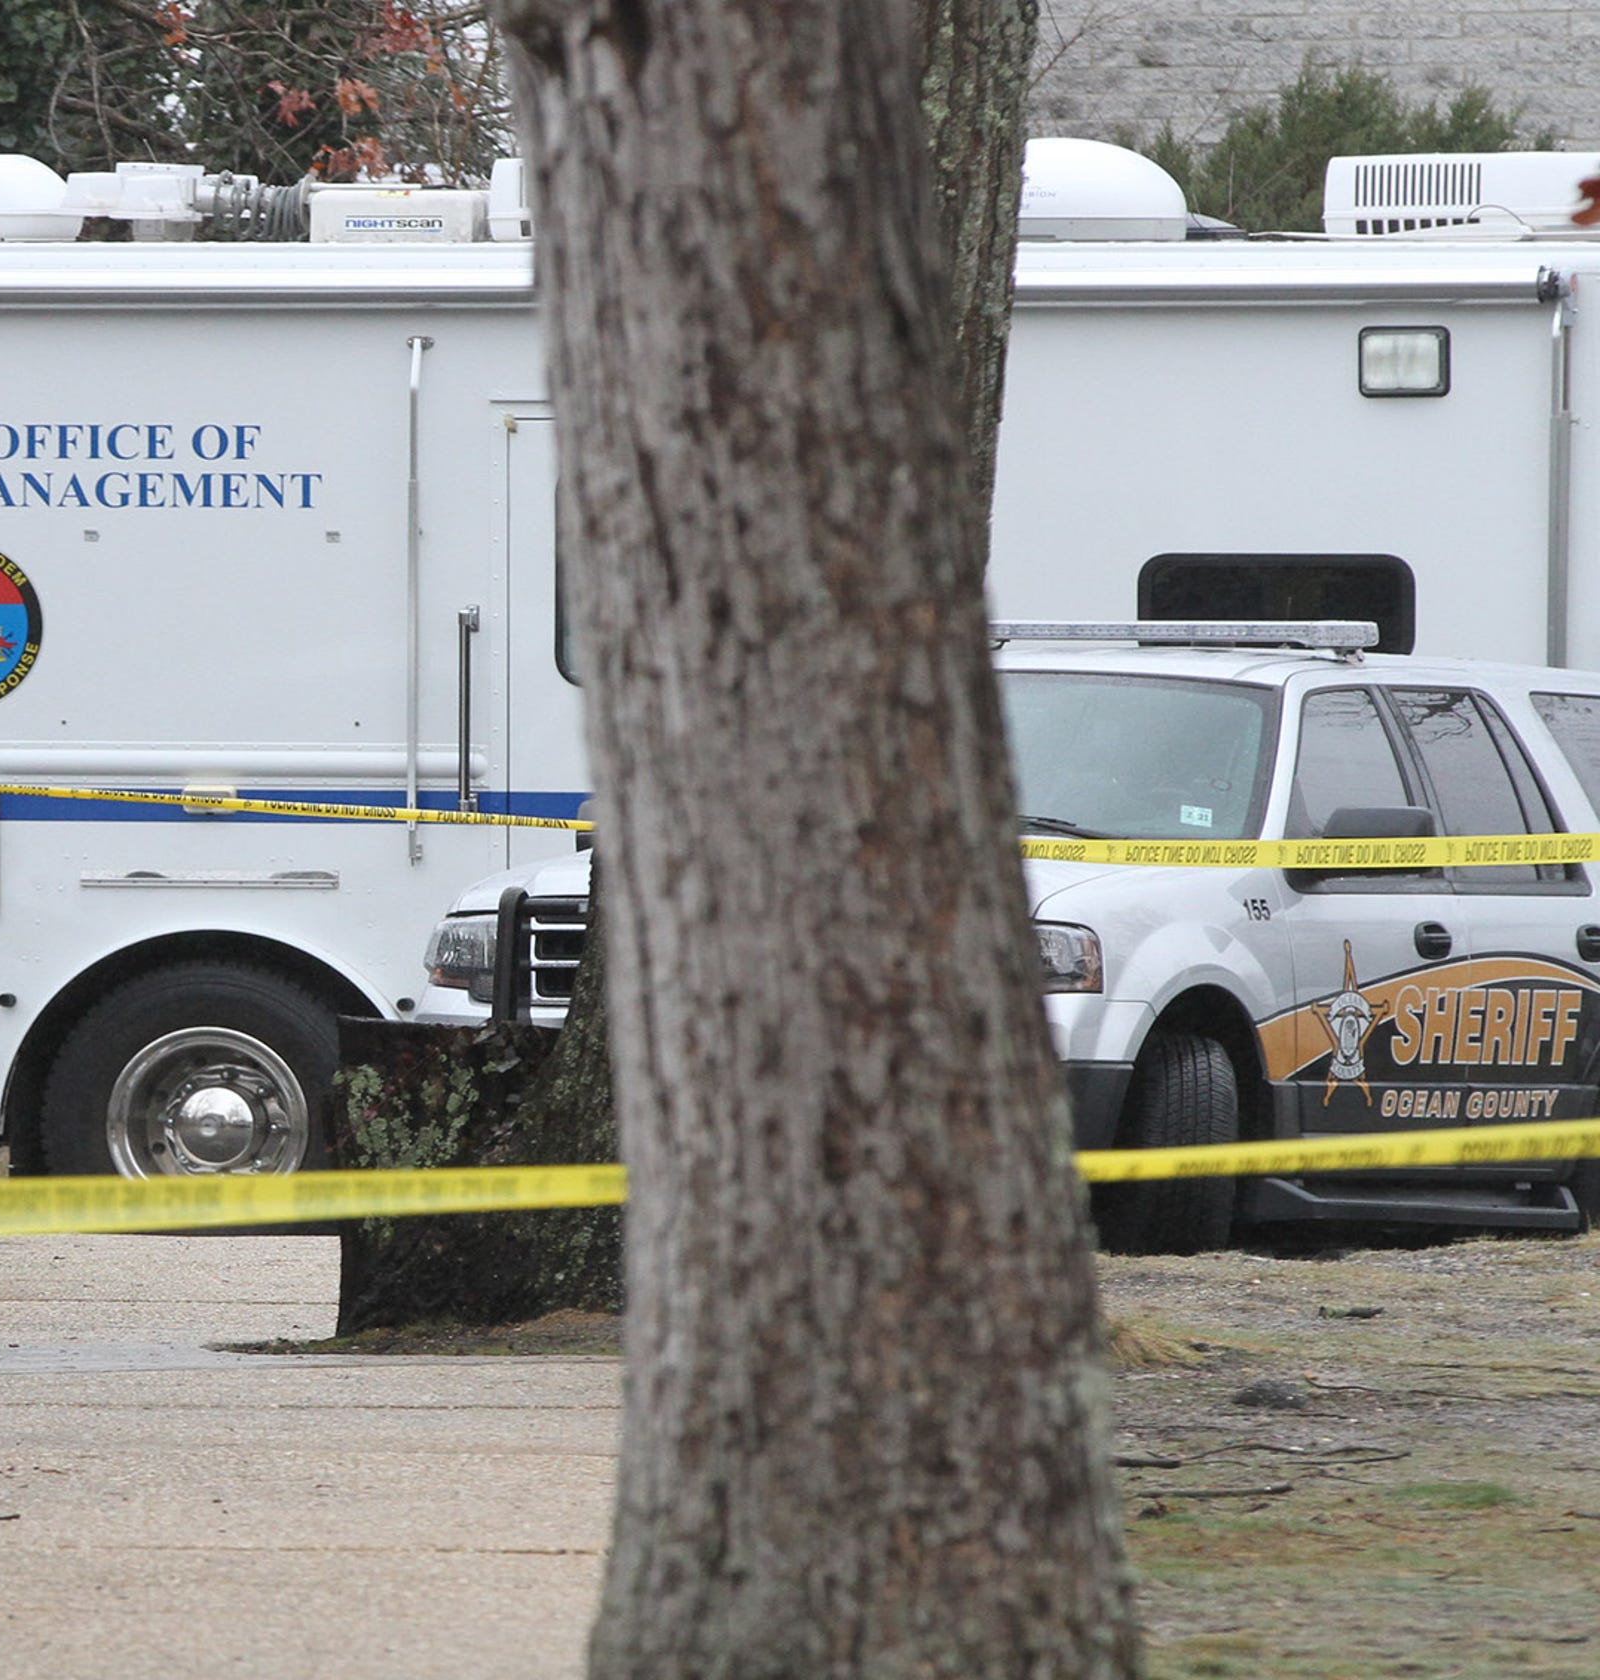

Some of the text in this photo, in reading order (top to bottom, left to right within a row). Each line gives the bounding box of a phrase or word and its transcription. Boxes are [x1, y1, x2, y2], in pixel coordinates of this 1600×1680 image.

[191, 424, 262, 460] OF
[1243, 898, 1271, 921] 155
[1390, 984, 1583, 1067] SHERIFF
[1381, 1089, 1559, 1119] OCEAN COUNTY
